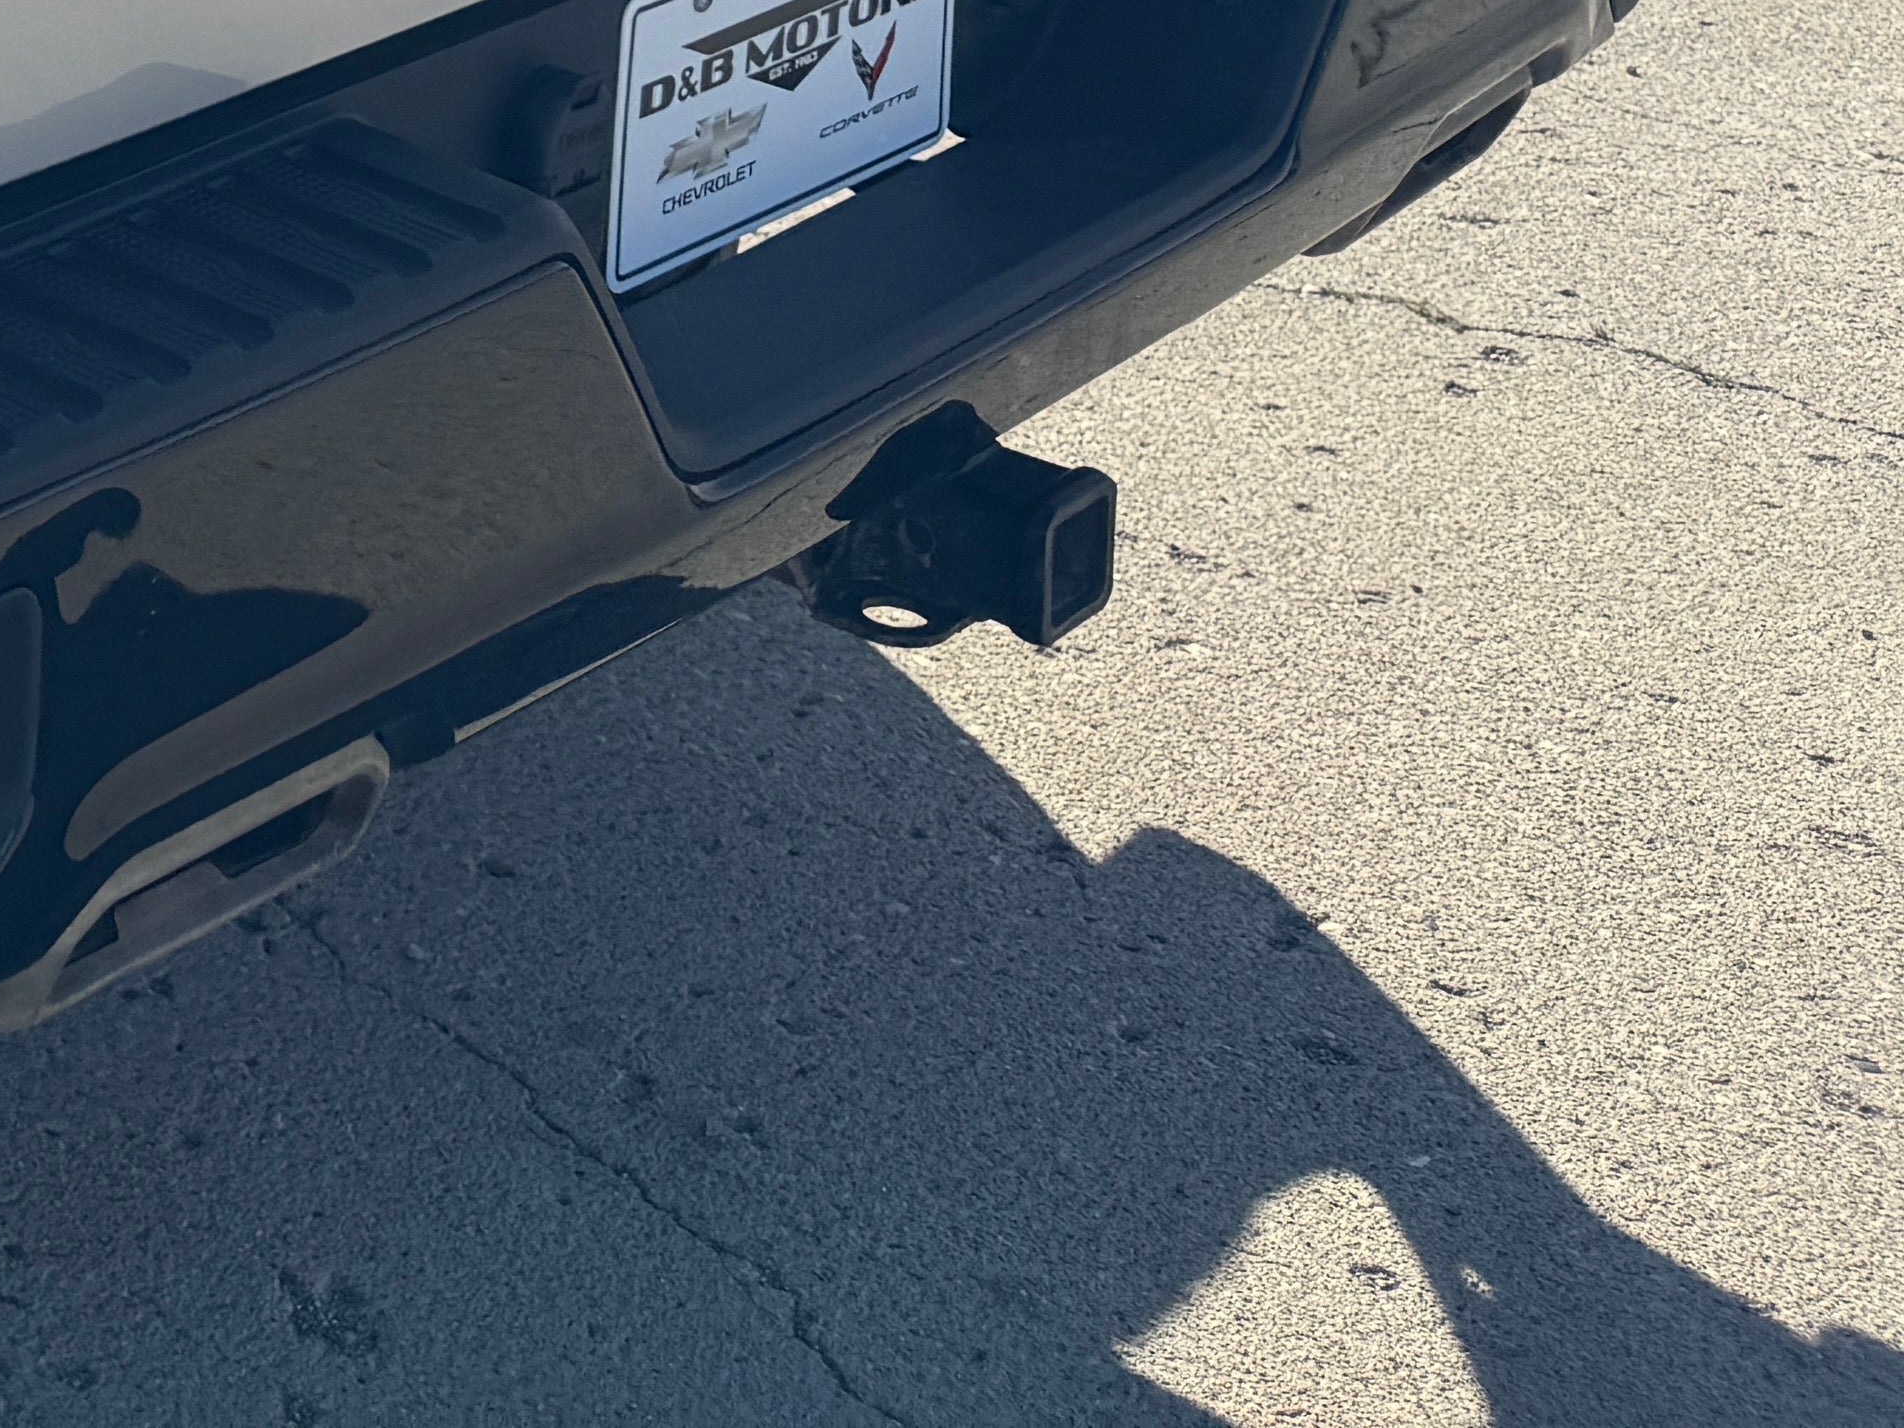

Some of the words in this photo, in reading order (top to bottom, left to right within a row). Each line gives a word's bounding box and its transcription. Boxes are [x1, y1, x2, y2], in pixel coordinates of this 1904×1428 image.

[639, 48, 734, 119] D&B
[819, 85, 919, 139] CORVETTE
[662, 160, 757, 215] CHEVROLET
